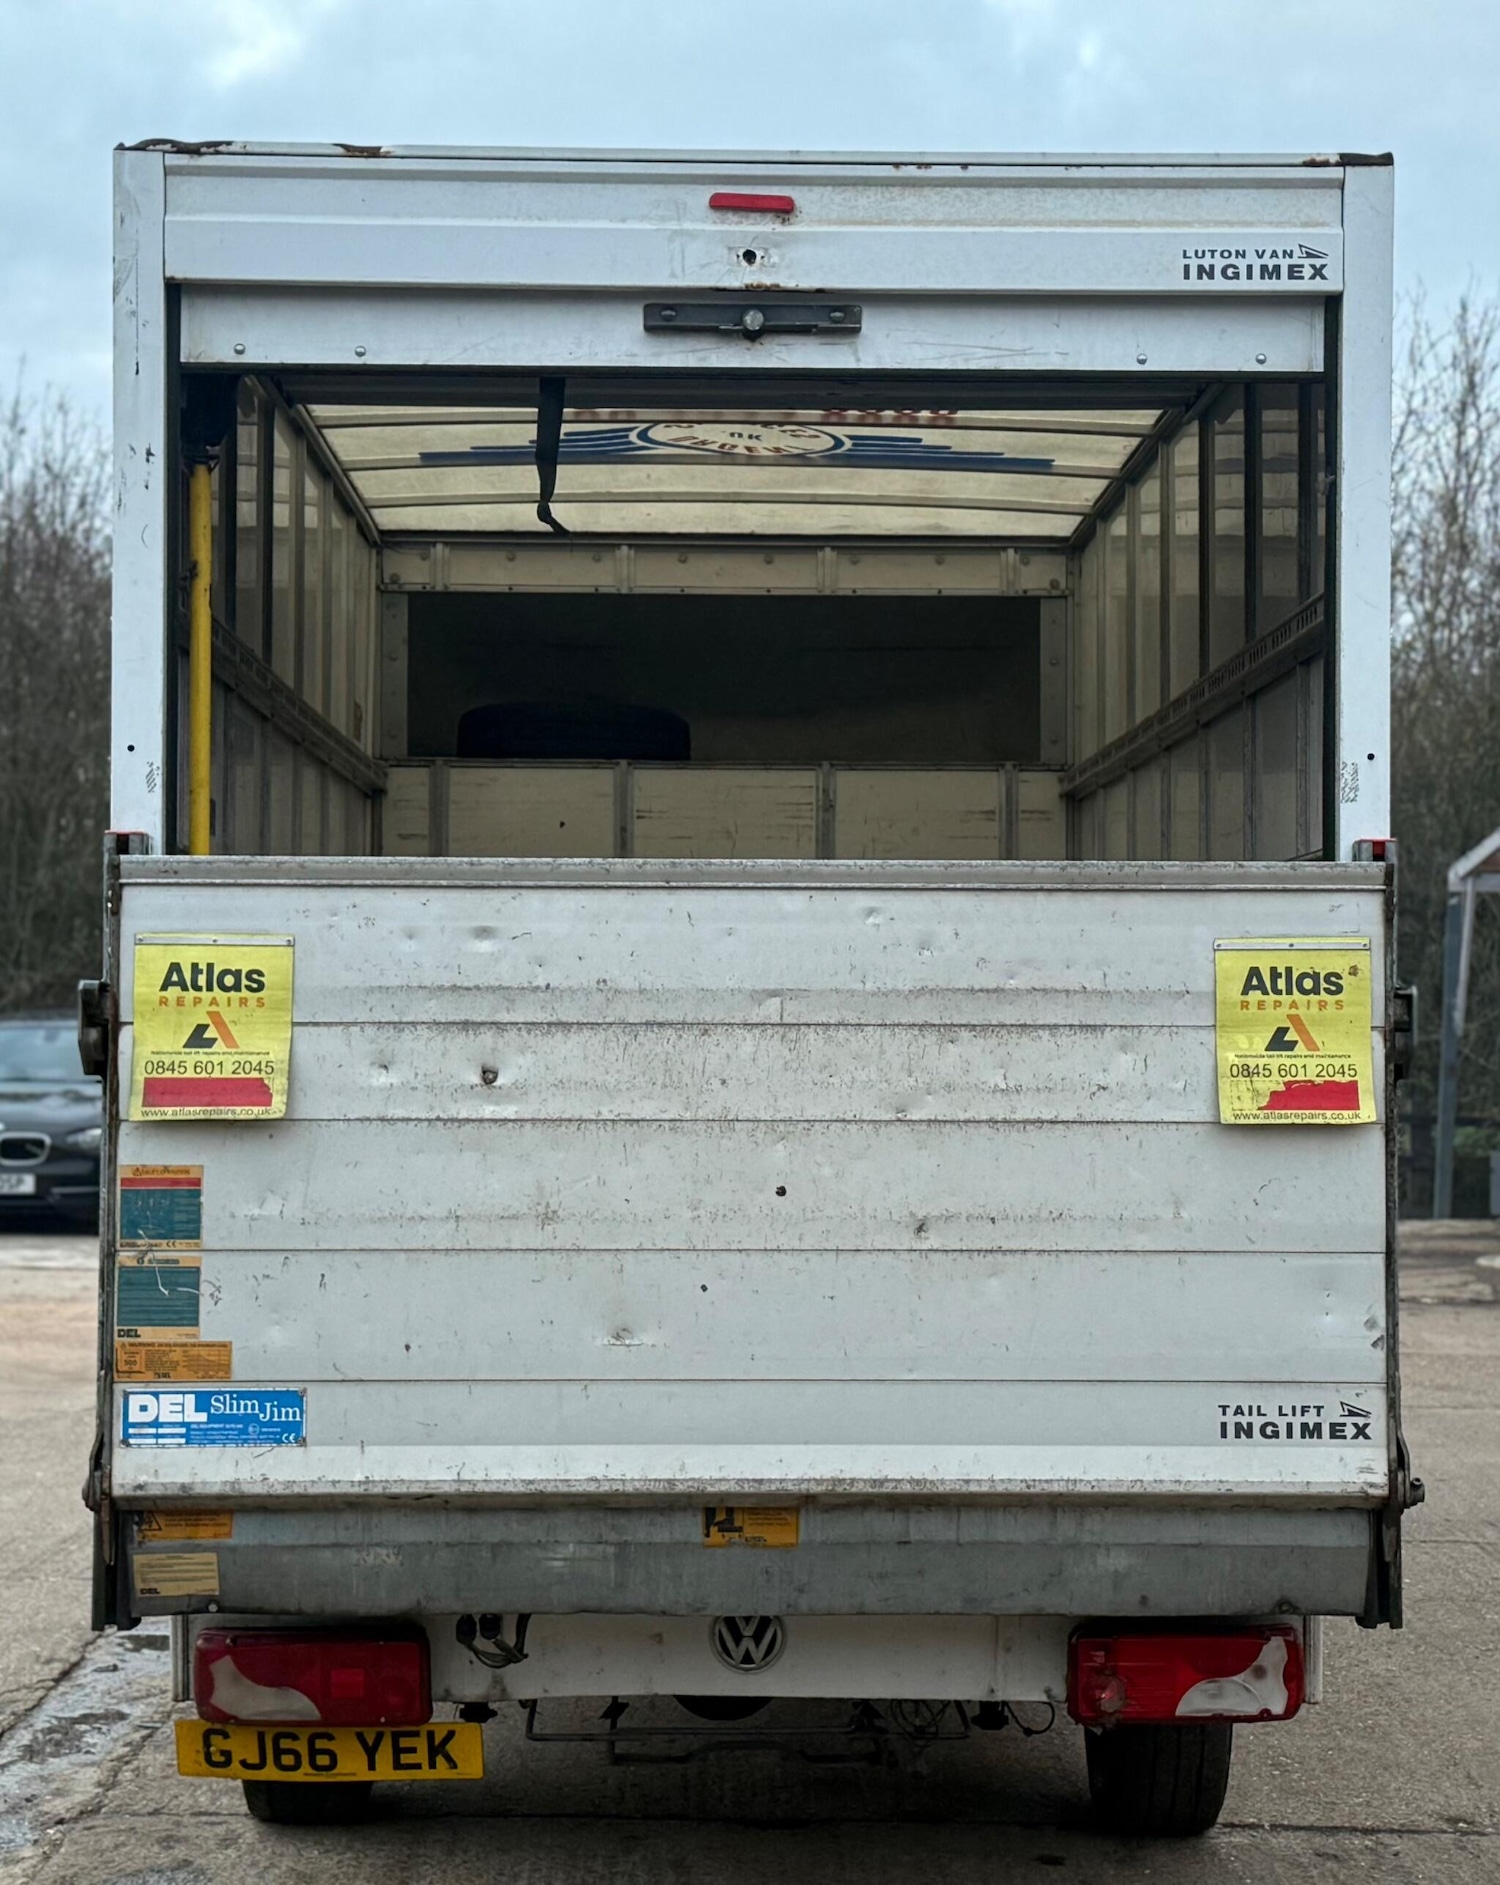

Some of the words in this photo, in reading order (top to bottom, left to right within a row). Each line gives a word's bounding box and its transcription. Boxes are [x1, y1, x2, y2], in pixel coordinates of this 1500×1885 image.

[1182, 249, 1246, 259] LUTON
[1255, 249, 1294, 259] VAN
[1183, 263, 1329, 281] INGIMEX
[158, 961, 266, 993] Atlas
[1240, 966, 1344, 996] Atlas
[158, 996, 265, 1008] REPAIRS
[1240, 999, 1344, 1011] REPAIRS
[144, 1060, 187, 1075] 0845
[193, 1060, 224, 1075] 601
[231, 1060, 275, 1075] 2045
[1230, 1063, 1272, 1078] 0845
[1278, 1063, 1308, 1078] 601
[1315, 1063, 1358, 1078] 2045
[141, 1106, 271, 1118] www.atlasrepairs.co.uk
[1233, 1111, 1361, 1121] www.atlasrepairs.co.uk
[117, 1328, 141, 1338] DEL
[128, 1393, 208, 1423] DEL
[210, 1393, 259, 1415] Slim
[258, 1401, 302, 1422] Jim
[1217, 1404, 1267, 1417] TAIL
[1278, 1404, 1325, 1417] LIFT
[1219, 1421, 1372, 1440] INGIMEX
[202, 1727, 338, 1773] GJ66
[355, 1729, 458, 1772] YEK
